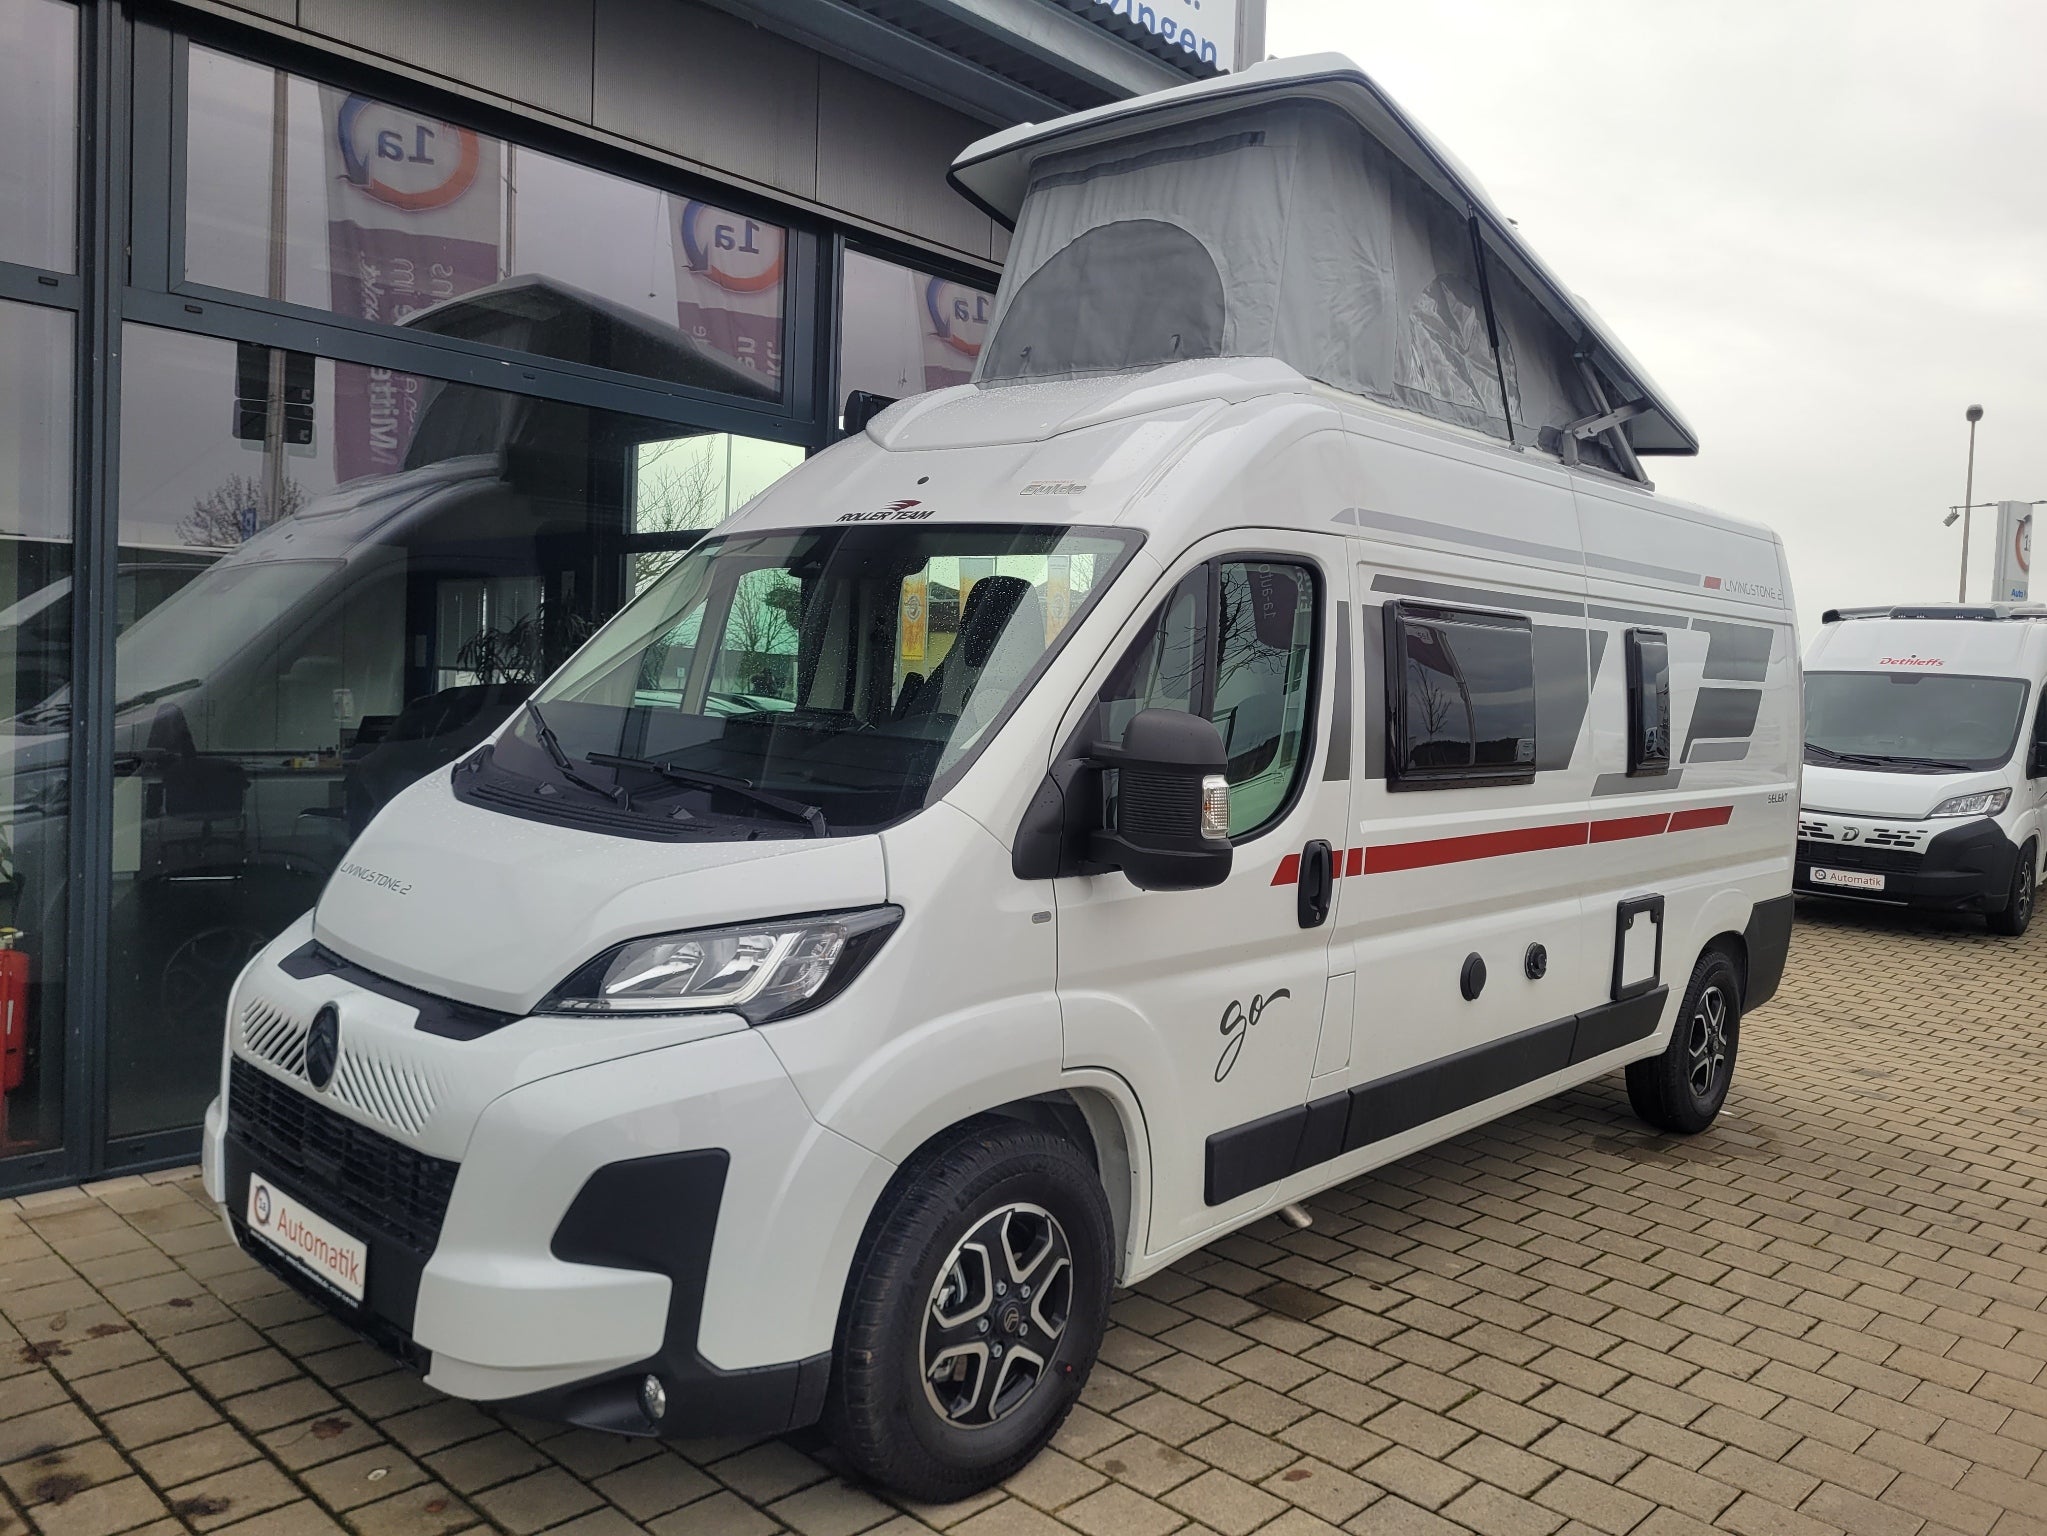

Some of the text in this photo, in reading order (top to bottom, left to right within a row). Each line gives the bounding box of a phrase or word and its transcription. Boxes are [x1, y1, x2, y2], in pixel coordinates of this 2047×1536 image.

[836, 510, 936, 523] ROLLER TEAM
[1724, 580, 1776, 599] LIVINGSTONE
[1880, 657, 1944, 667] Dethleffs
[340, 862, 412, 896] LIVINGSTONE 2
[1829, 872, 1881, 887] Automatik
[1214, 987, 1291, 1083] go
[277, 1207, 360, 1286] Automatik
